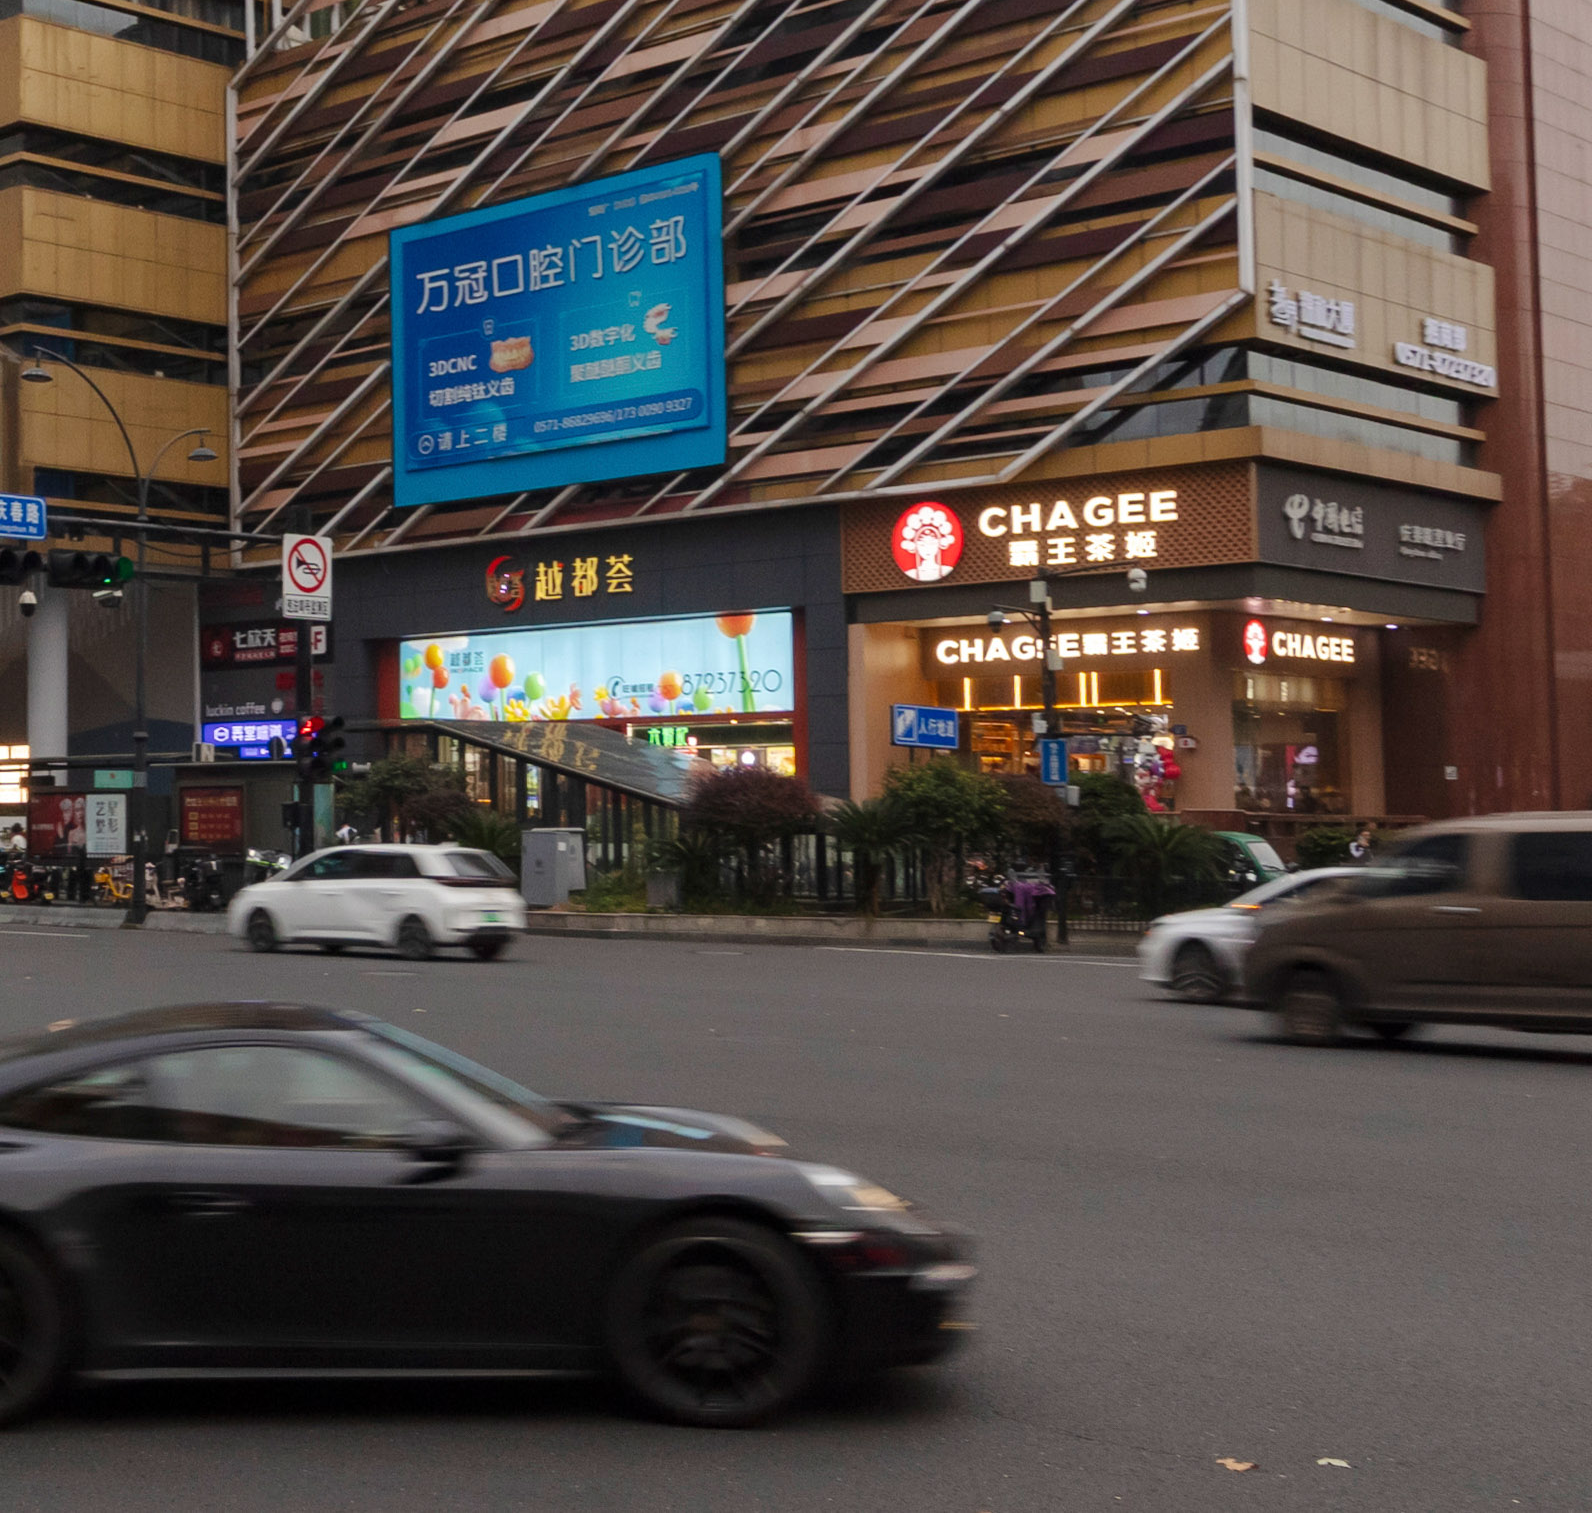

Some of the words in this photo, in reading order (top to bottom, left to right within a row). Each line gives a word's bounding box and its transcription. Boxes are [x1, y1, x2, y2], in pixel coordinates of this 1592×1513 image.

[416, 216, 687, 314] 万冠口腔门诊部
[570, 323, 636, 352] 3D数字化
[428, 354, 478, 378] 3DCNC
[428, 377, 515, 408] 切割纯钛义齿
[437, 424, 508, 452] 请上二楼
[979, 489, 1179, 537] CHAGEE
[1312, 498, 1364, 535] 中国电信
[1008, 530, 1159, 567] 霸王茶姬
[534, 554, 634, 602] 越都荟
[1082, 628, 1201, 656] 霸王茶姬
[1272, 630, 1356, 664] CHAGEE
[681, 669, 783, 696] 87237320
[918, 717, 955, 737] 人行地道
